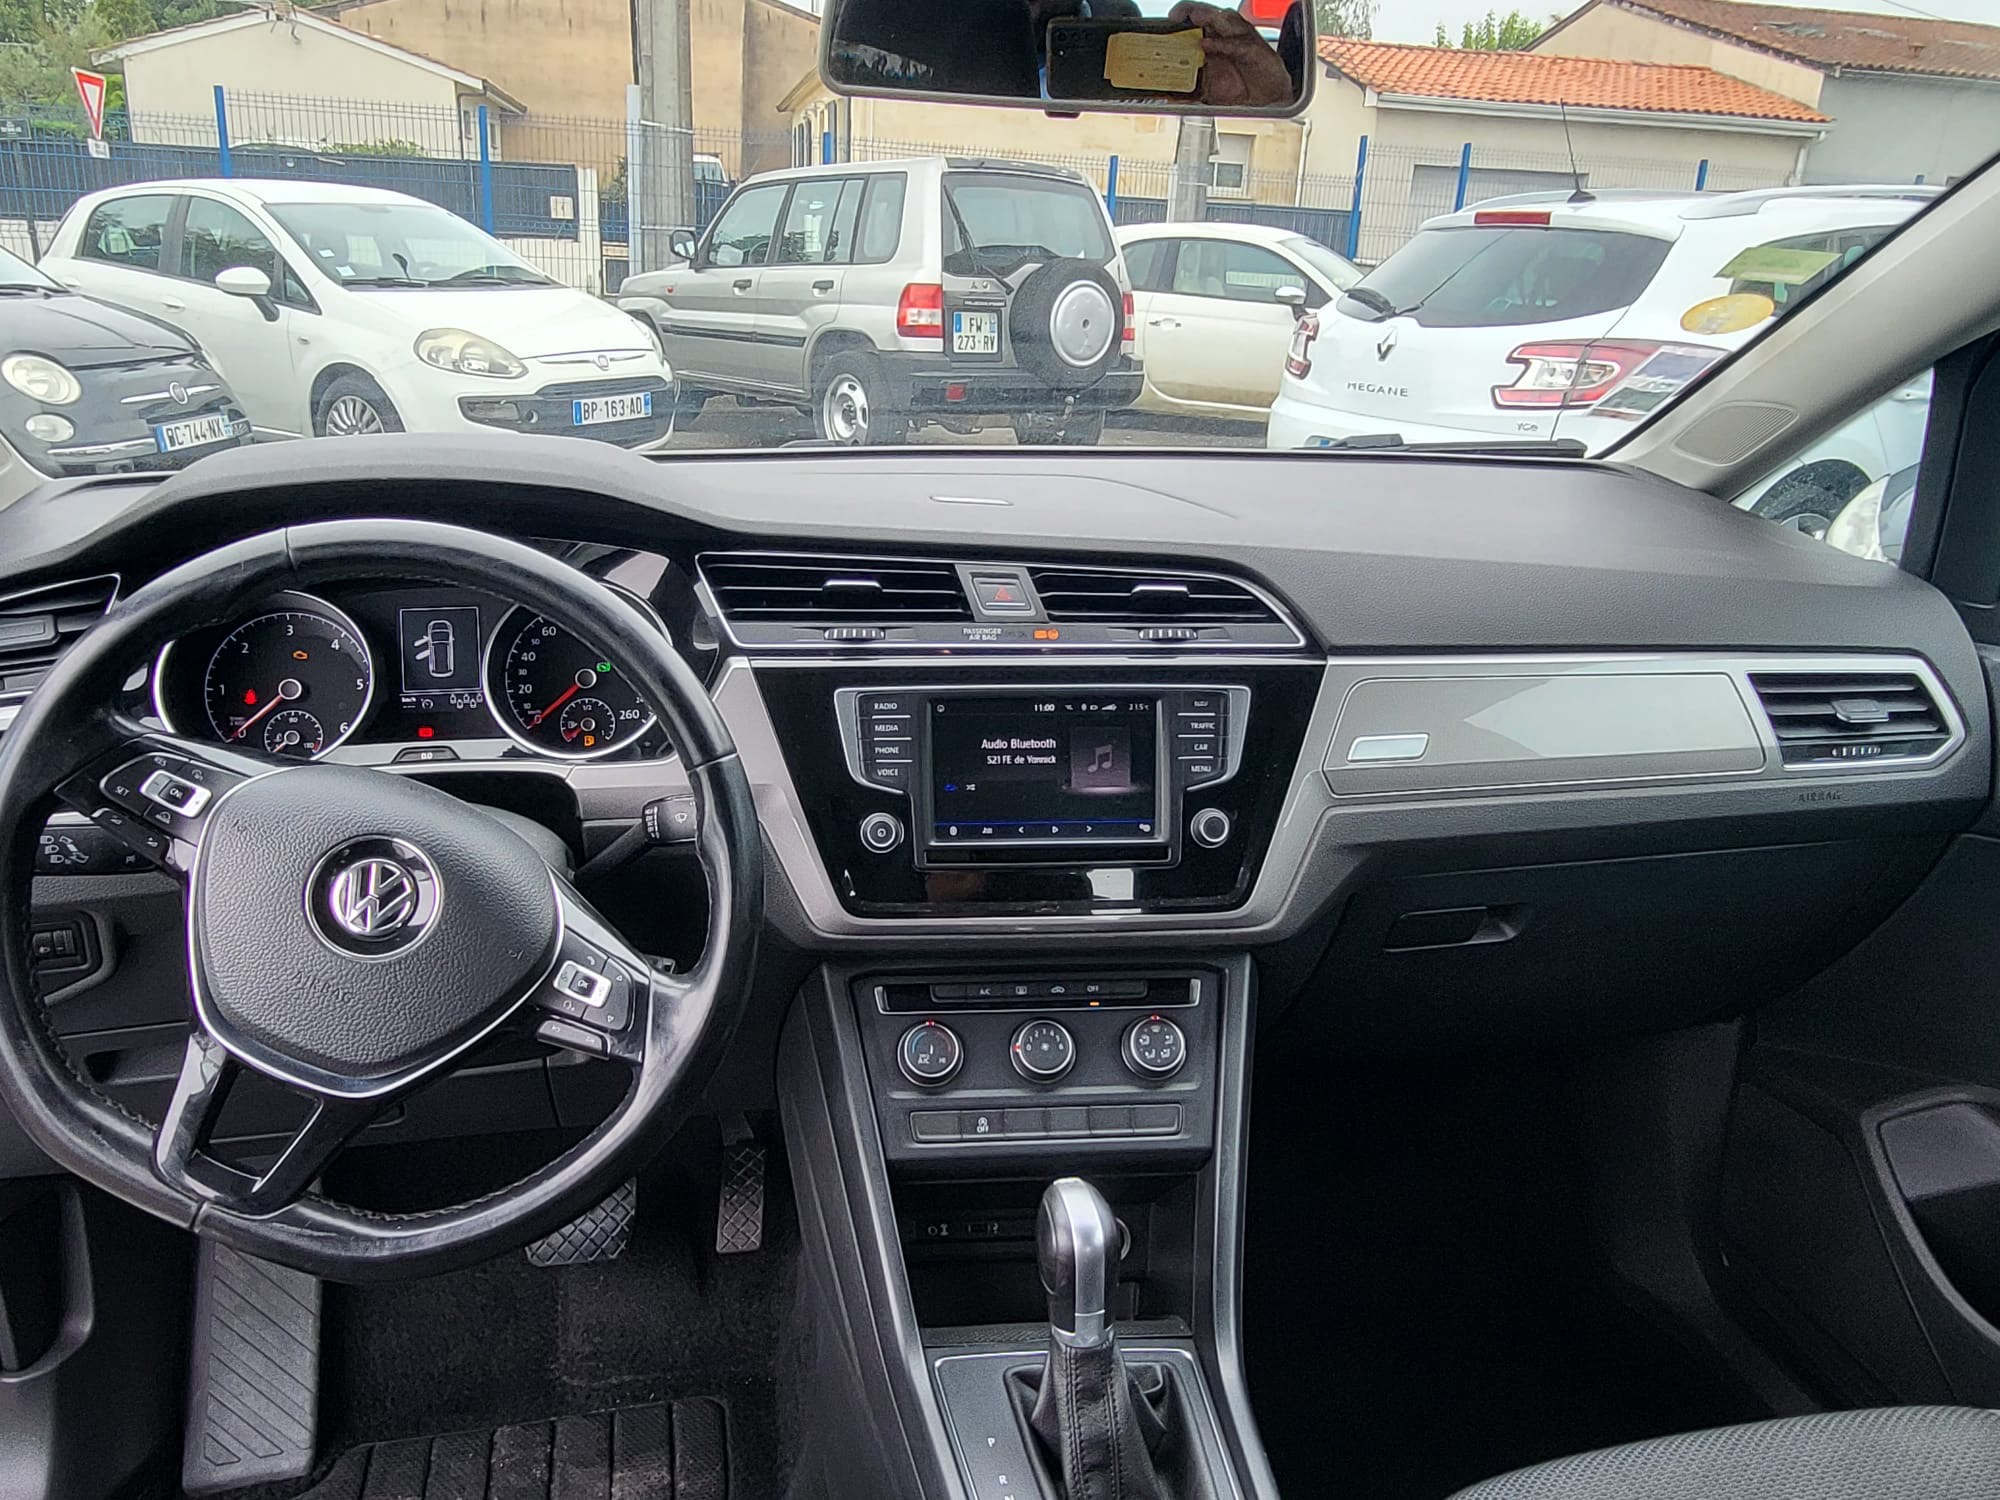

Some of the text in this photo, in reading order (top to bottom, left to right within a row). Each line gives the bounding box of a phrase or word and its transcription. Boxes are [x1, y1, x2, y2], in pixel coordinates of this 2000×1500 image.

[1347, 382, 1409, 397] MEGANE
[286, 625, 293, 639] 3
[541, 627, 557, 636] 60
[963, 627, 1002, 635] PASSENGER
[241, 643, 249, 654] 2
[331, 639, 341, 652] 4
[521, 652, 536, 662] 40
[356, 678, 365, 691] 5
[519, 684, 533, 694] 20
[219, 684, 226, 696] 1
[874, 702, 898, 710] RADIO
[1034, 703, 1055, 712] 11:00
[619, 710, 640, 720] 260
[340, 721, 350, 734] 6
[874, 724, 899, 733] MEDIA
[1190, 722, 1215, 730] TRAFFIC
[981, 738, 1056, 752] Audio Bluetooth
[1194, 744, 1208, 752] CAR
[875, 746, 899, 755] PHONE
[1014, 754, 1025, 764] de
[877, 769, 898, 777] VOICE
[1191, 766, 1211, 774] MENU
[1087, 985, 1099, 993] OFF
[987, 1437, 996, 1448] P
[998, 1475, 1008, 1486] R
